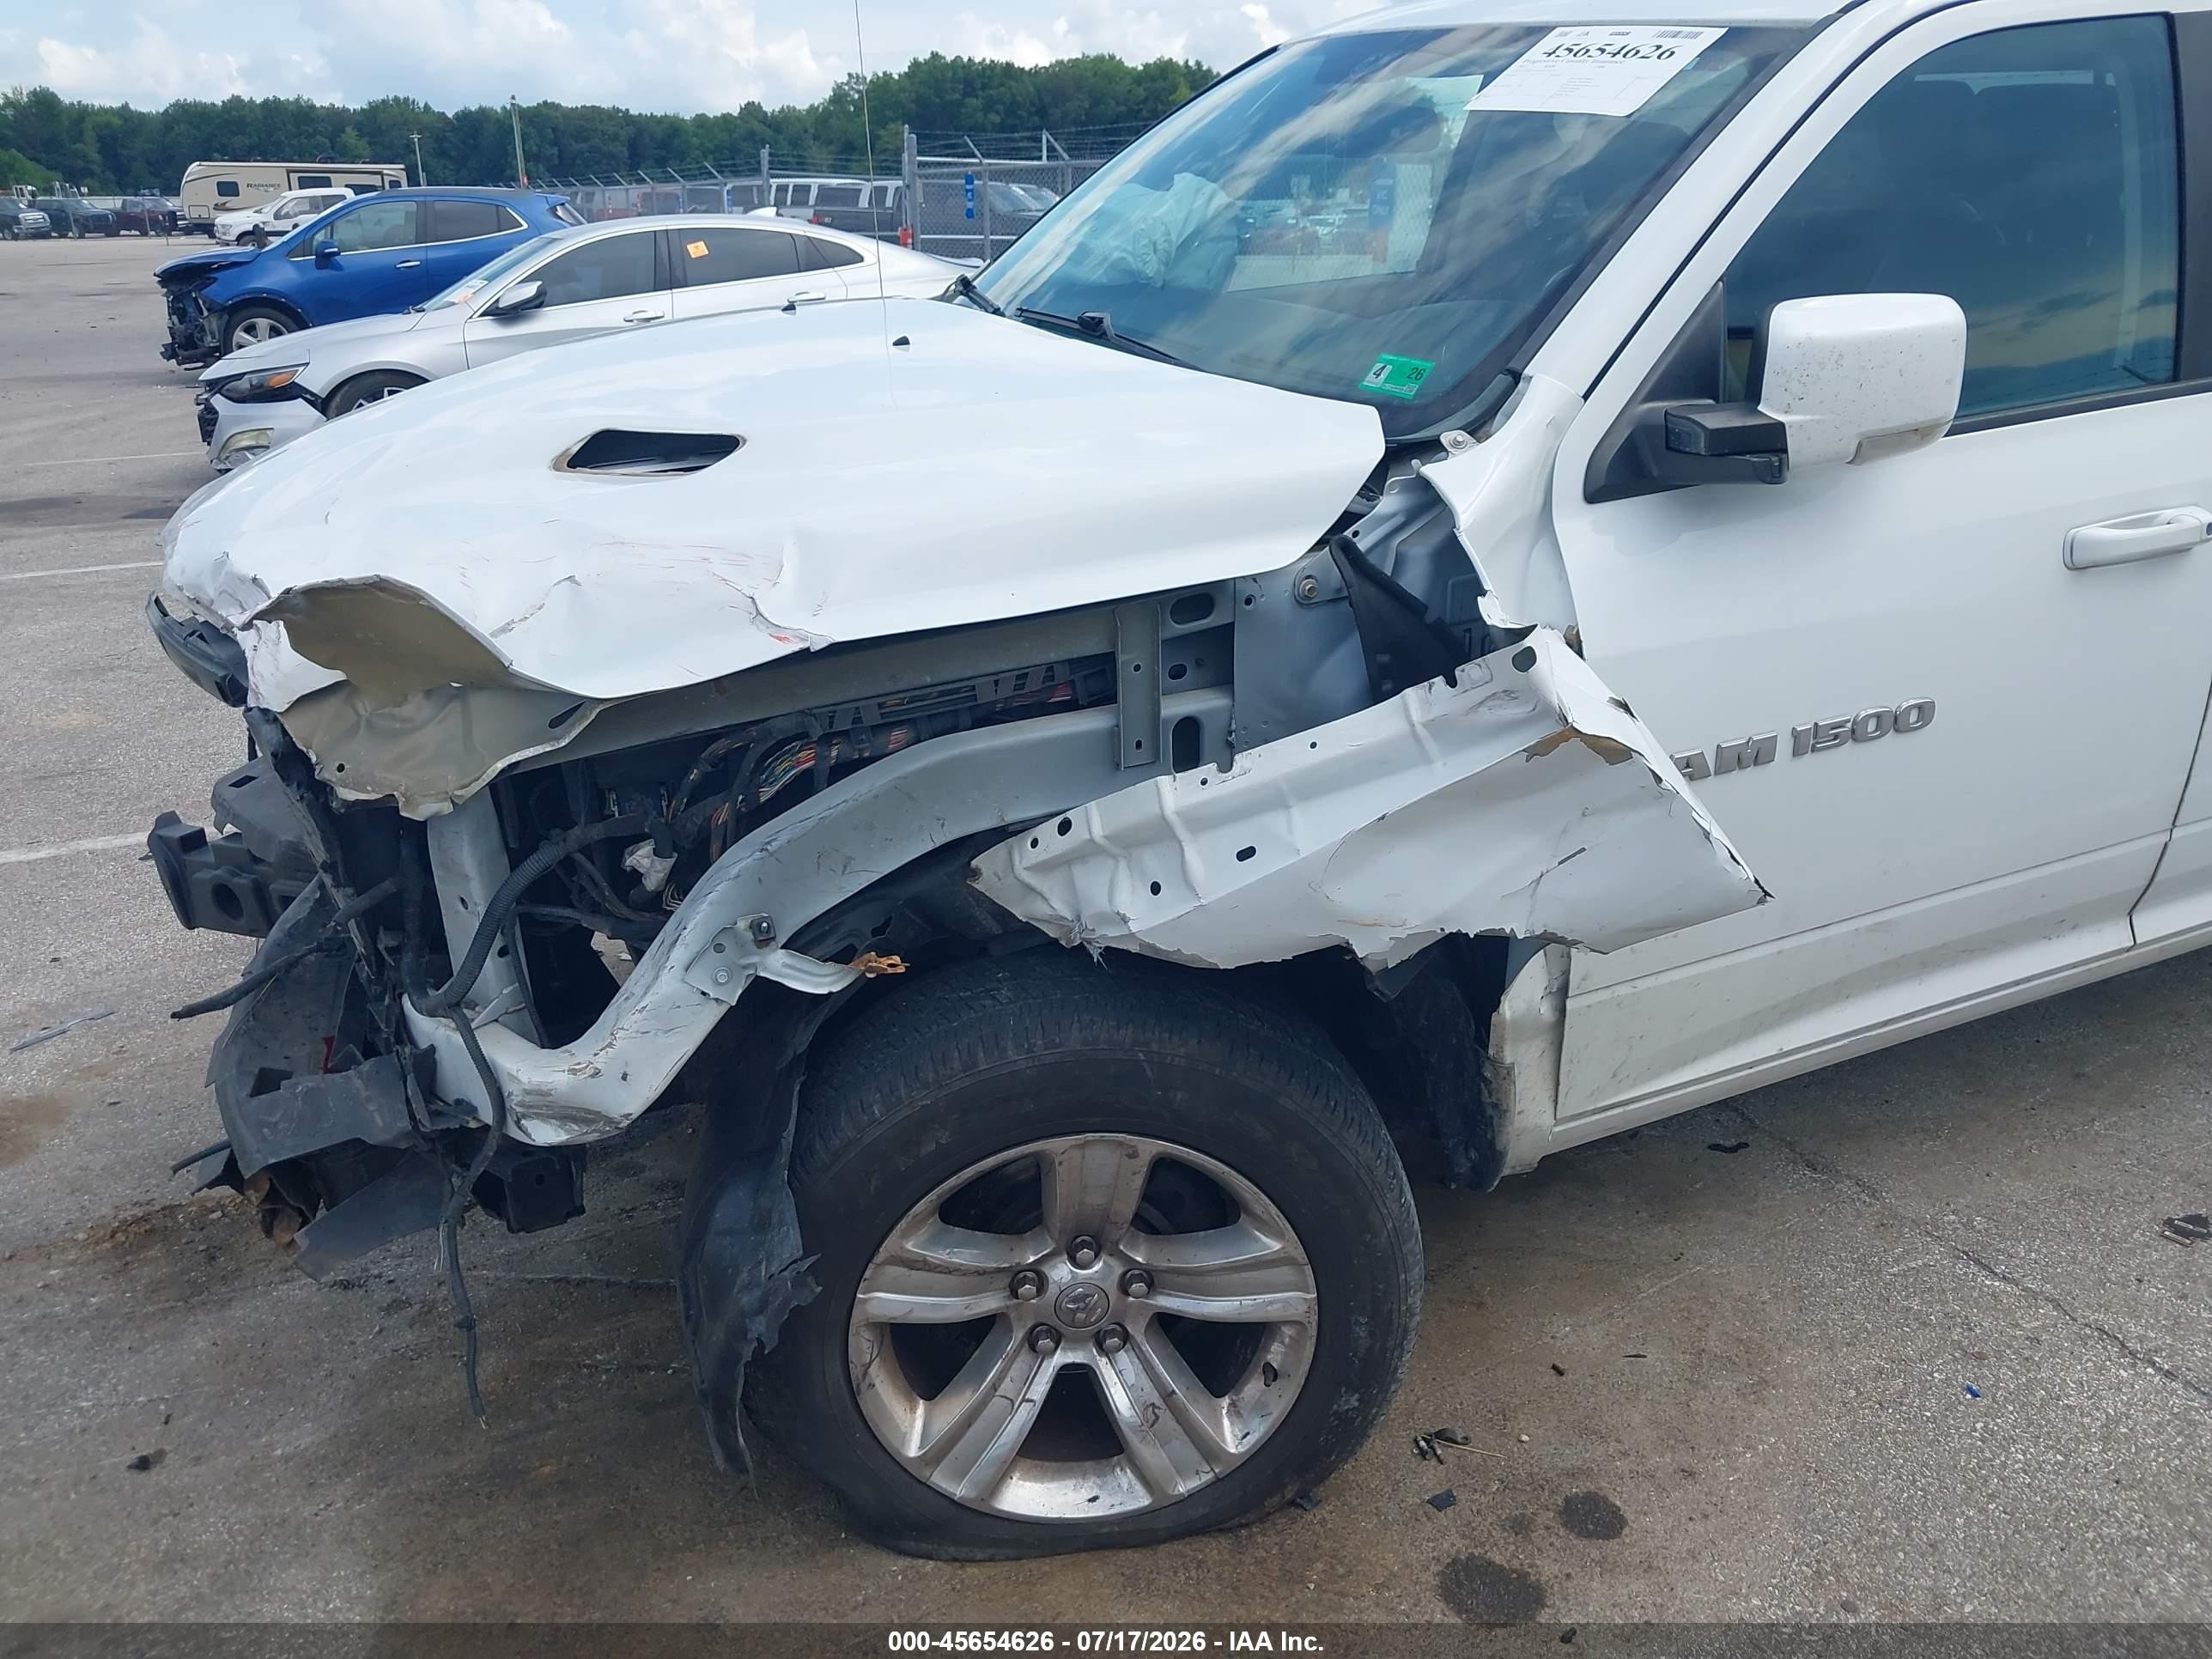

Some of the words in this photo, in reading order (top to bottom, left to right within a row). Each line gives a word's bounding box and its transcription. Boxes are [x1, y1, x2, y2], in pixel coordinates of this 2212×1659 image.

[1542, 43, 1684, 61] 45654626
[1373, 364, 1388, 379] 4
[1407, 367, 1426, 381] 26
[1669, 731, 1778, 781] AM
[1791, 696, 1936, 758] 1500
